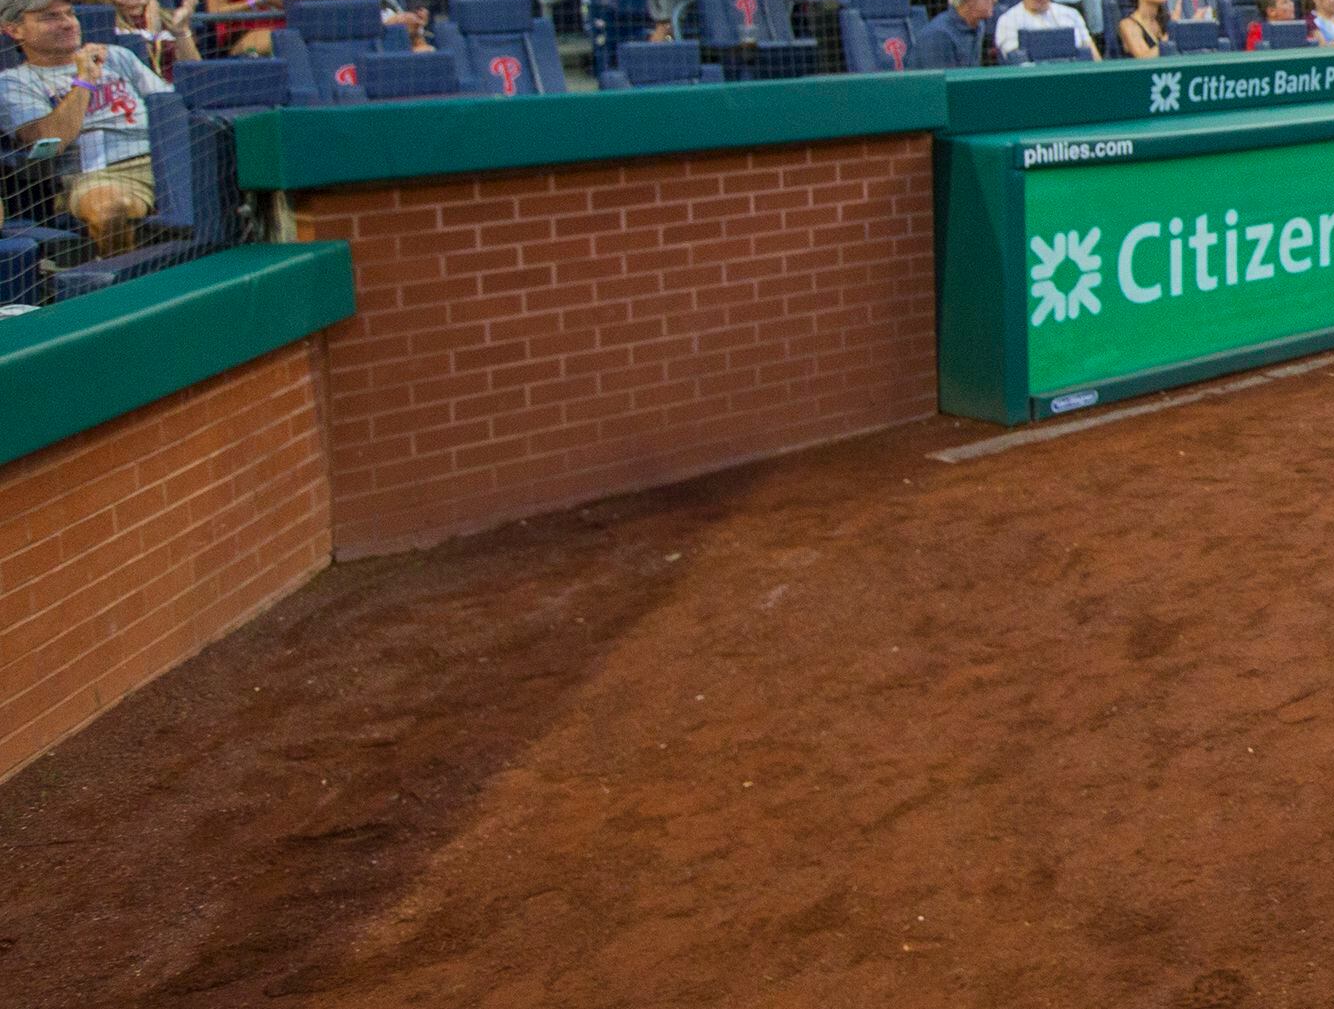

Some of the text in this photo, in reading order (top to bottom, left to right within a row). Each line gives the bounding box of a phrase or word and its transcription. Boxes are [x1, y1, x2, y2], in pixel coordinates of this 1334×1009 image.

[1188, 75, 1270, 102] Citizens
[1274, 66, 1321, 95] Bank
[1023, 139, 1134, 170] phillies.com
